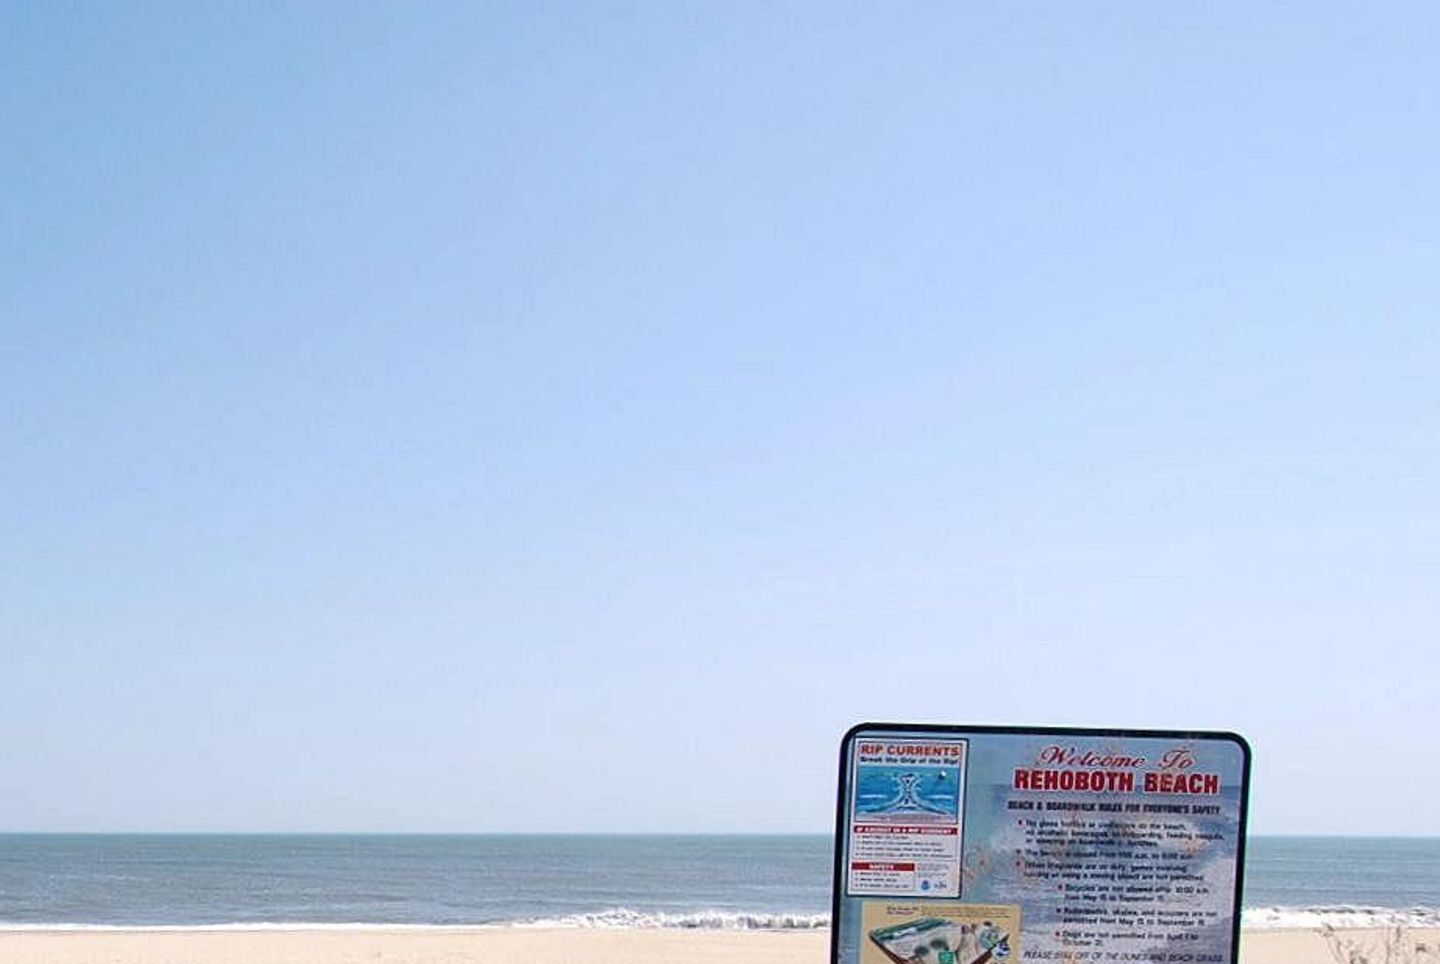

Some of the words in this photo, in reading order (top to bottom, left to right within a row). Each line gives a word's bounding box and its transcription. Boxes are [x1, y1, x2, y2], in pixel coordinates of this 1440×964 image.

[861, 744, 883, 755] RIP
[887, 745, 960, 756] CURRENTS
[1037, 746, 1145, 768] Welcome
[1159, 749, 1194, 769] To
[1014, 769, 1134, 791] REHOBOTH
[1144, 773, 1218, 794] BEACH
[1008, 800, 1034, 811] BEACH
[1037, 801, 1043, 811] &
[1046, 801, 1096, 812] BOARDWALK
[1098, 803, 1122, 812] RULES
[1125, 804, 1140, 813] FOR
[1143, 804, 1189, 814] EVERYONE'S
[1192, 805, 1221, 815] SAFETY
